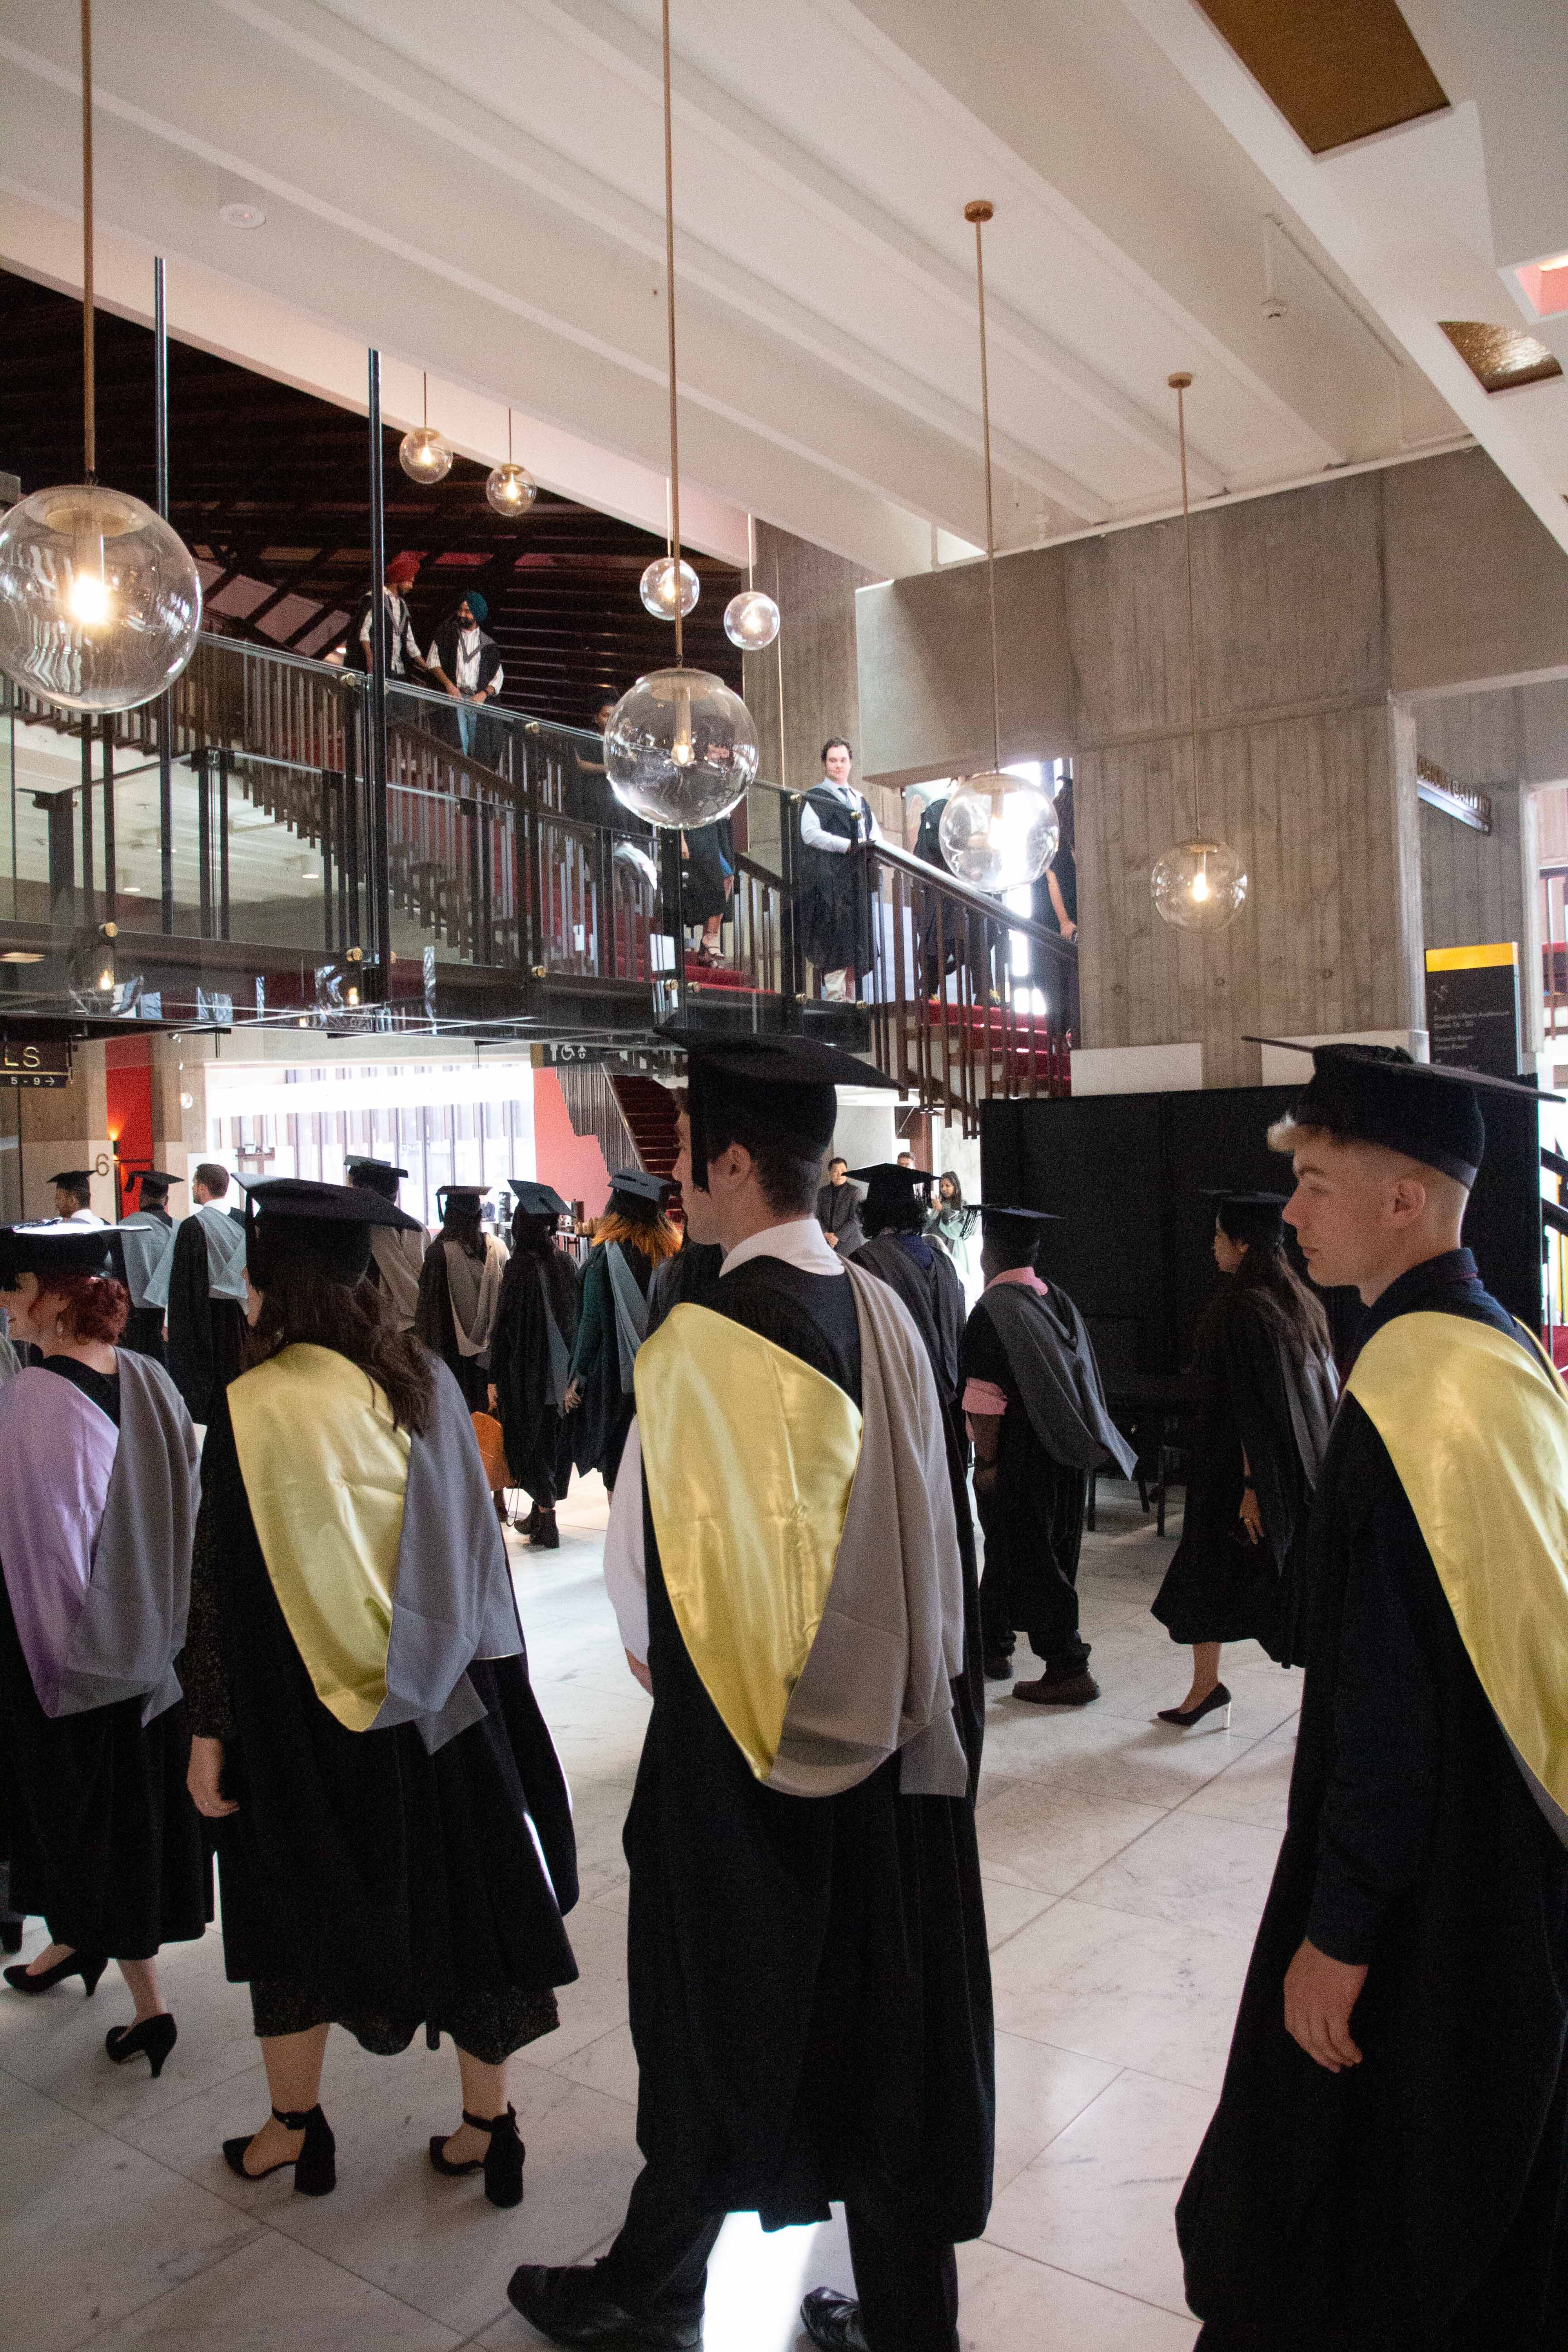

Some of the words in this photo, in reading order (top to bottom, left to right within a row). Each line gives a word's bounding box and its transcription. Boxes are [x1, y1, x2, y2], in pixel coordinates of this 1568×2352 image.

[11, 1077, 18, 1085] 5
[34, 1077, 40, 1085] 9
[95, 1153, 109, 1176] 6
